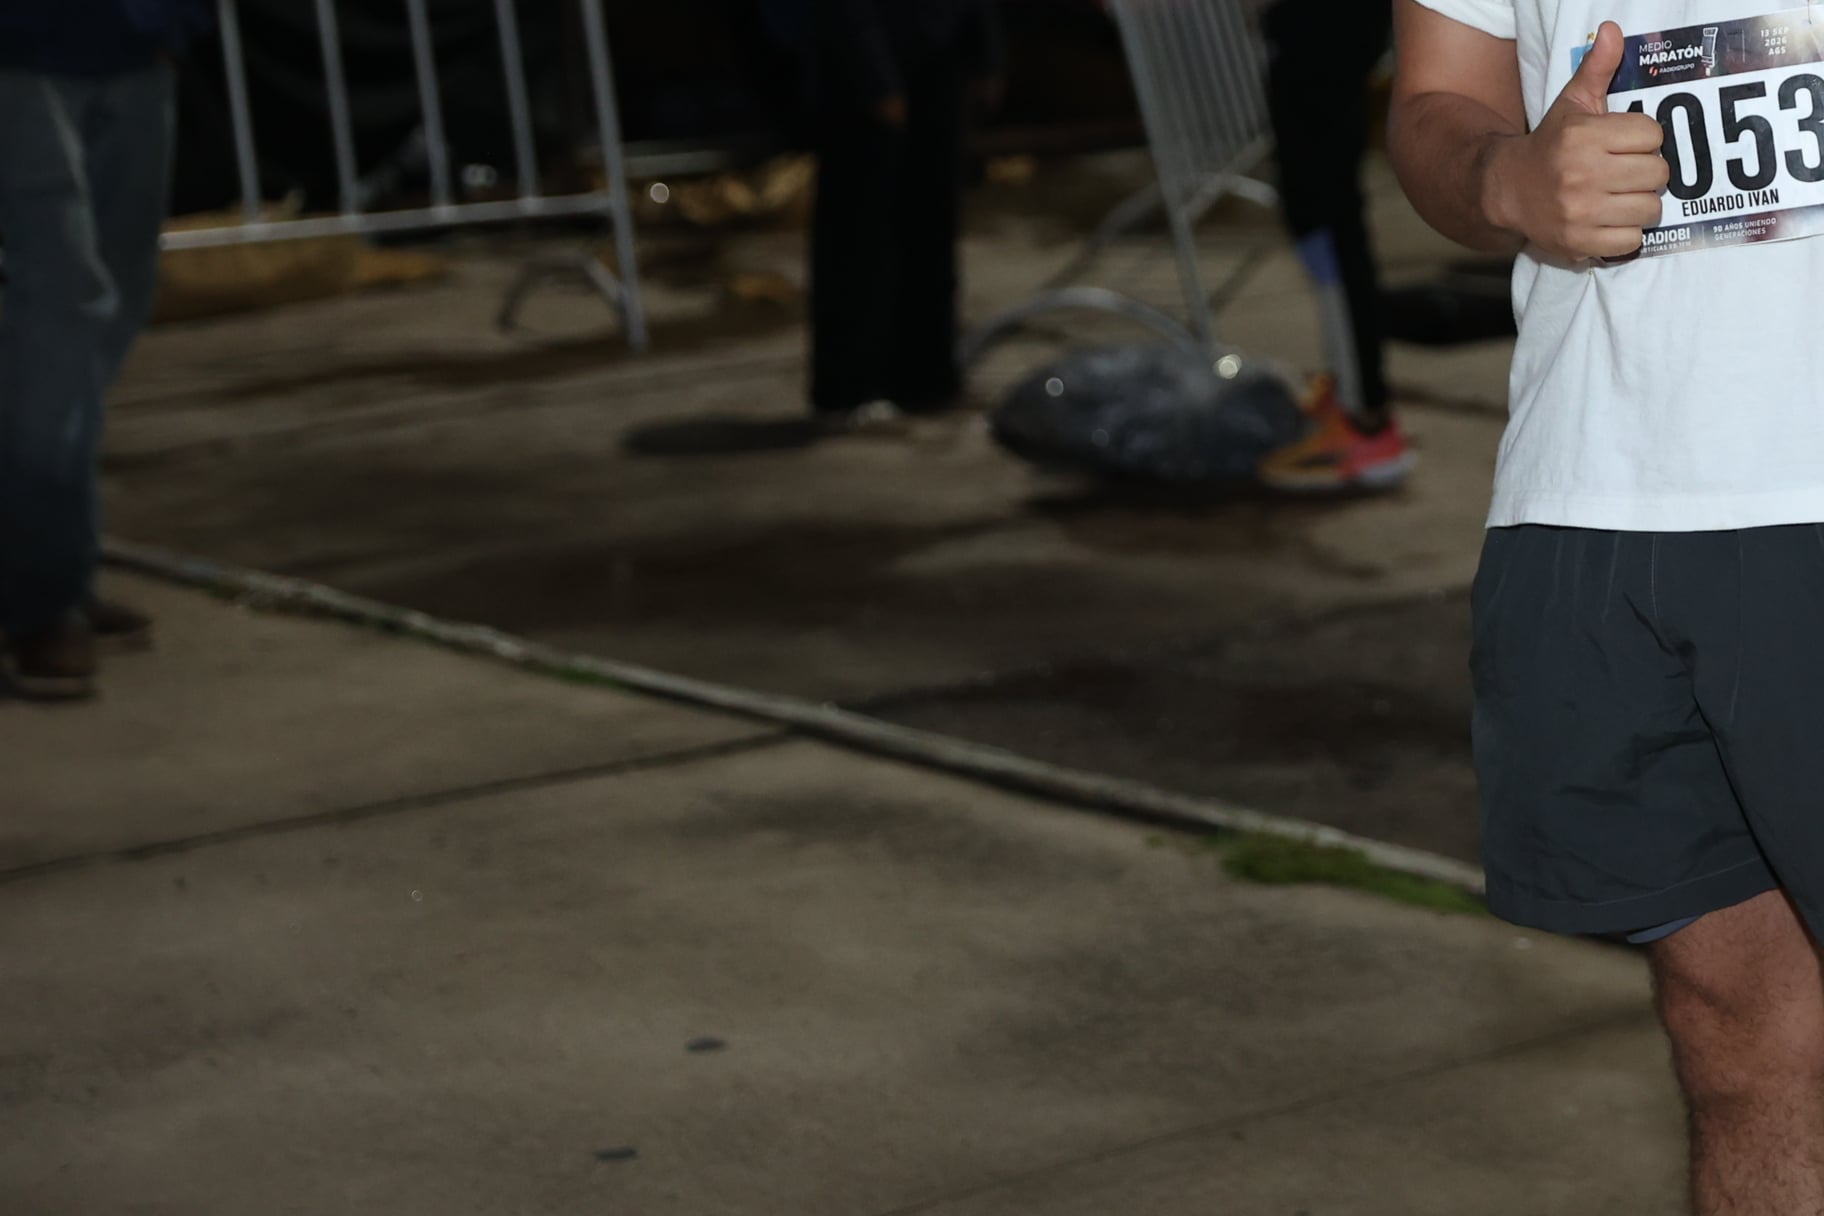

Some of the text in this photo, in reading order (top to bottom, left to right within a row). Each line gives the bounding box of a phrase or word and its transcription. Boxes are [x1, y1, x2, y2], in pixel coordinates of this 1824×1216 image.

[1761, 28, 1770, 38] 13
[1639, 39, 1672, 54] MEDIO
[1764, 36, 1788, 48] 2026
[1639, 43, 1704, 66] MARATÓN
[1682, 188, 1780, 217] EDUARDO IVAN
[1744, 216, 1777, 228] UNIENDO
[1714, 226, 1767, 241] GENERACIONES
